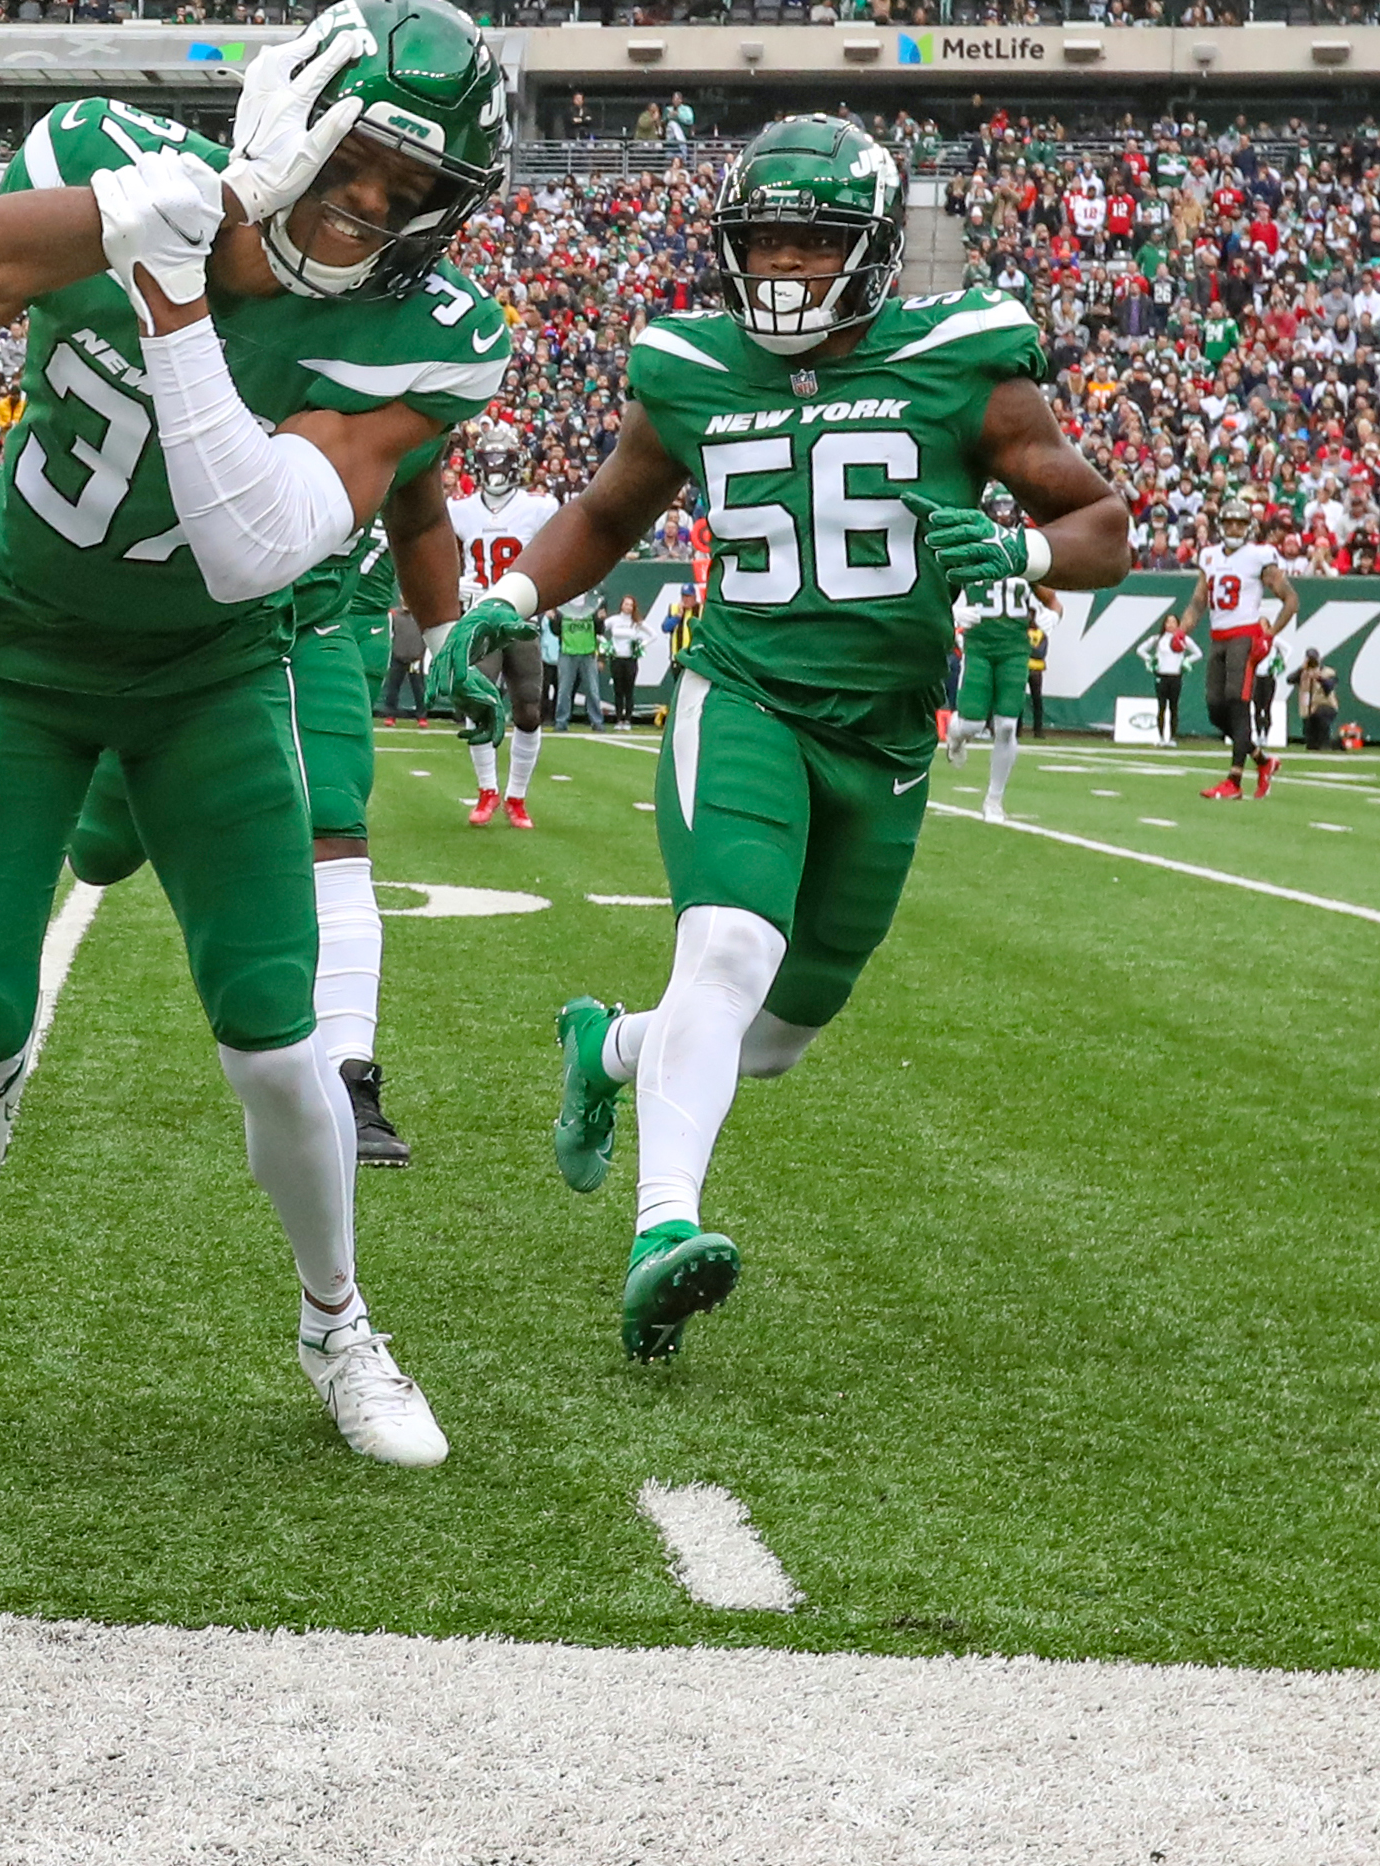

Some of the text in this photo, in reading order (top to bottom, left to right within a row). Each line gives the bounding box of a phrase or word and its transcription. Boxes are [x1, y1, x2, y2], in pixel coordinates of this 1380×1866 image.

[942, 37, 1045, 59] MetLife
[704, 399, 912, 435] NEW YORK
[701, 431, 919, 604] 56
[470, 536, 524, 589] 18
[1207, 574, 1242, 611] 13
